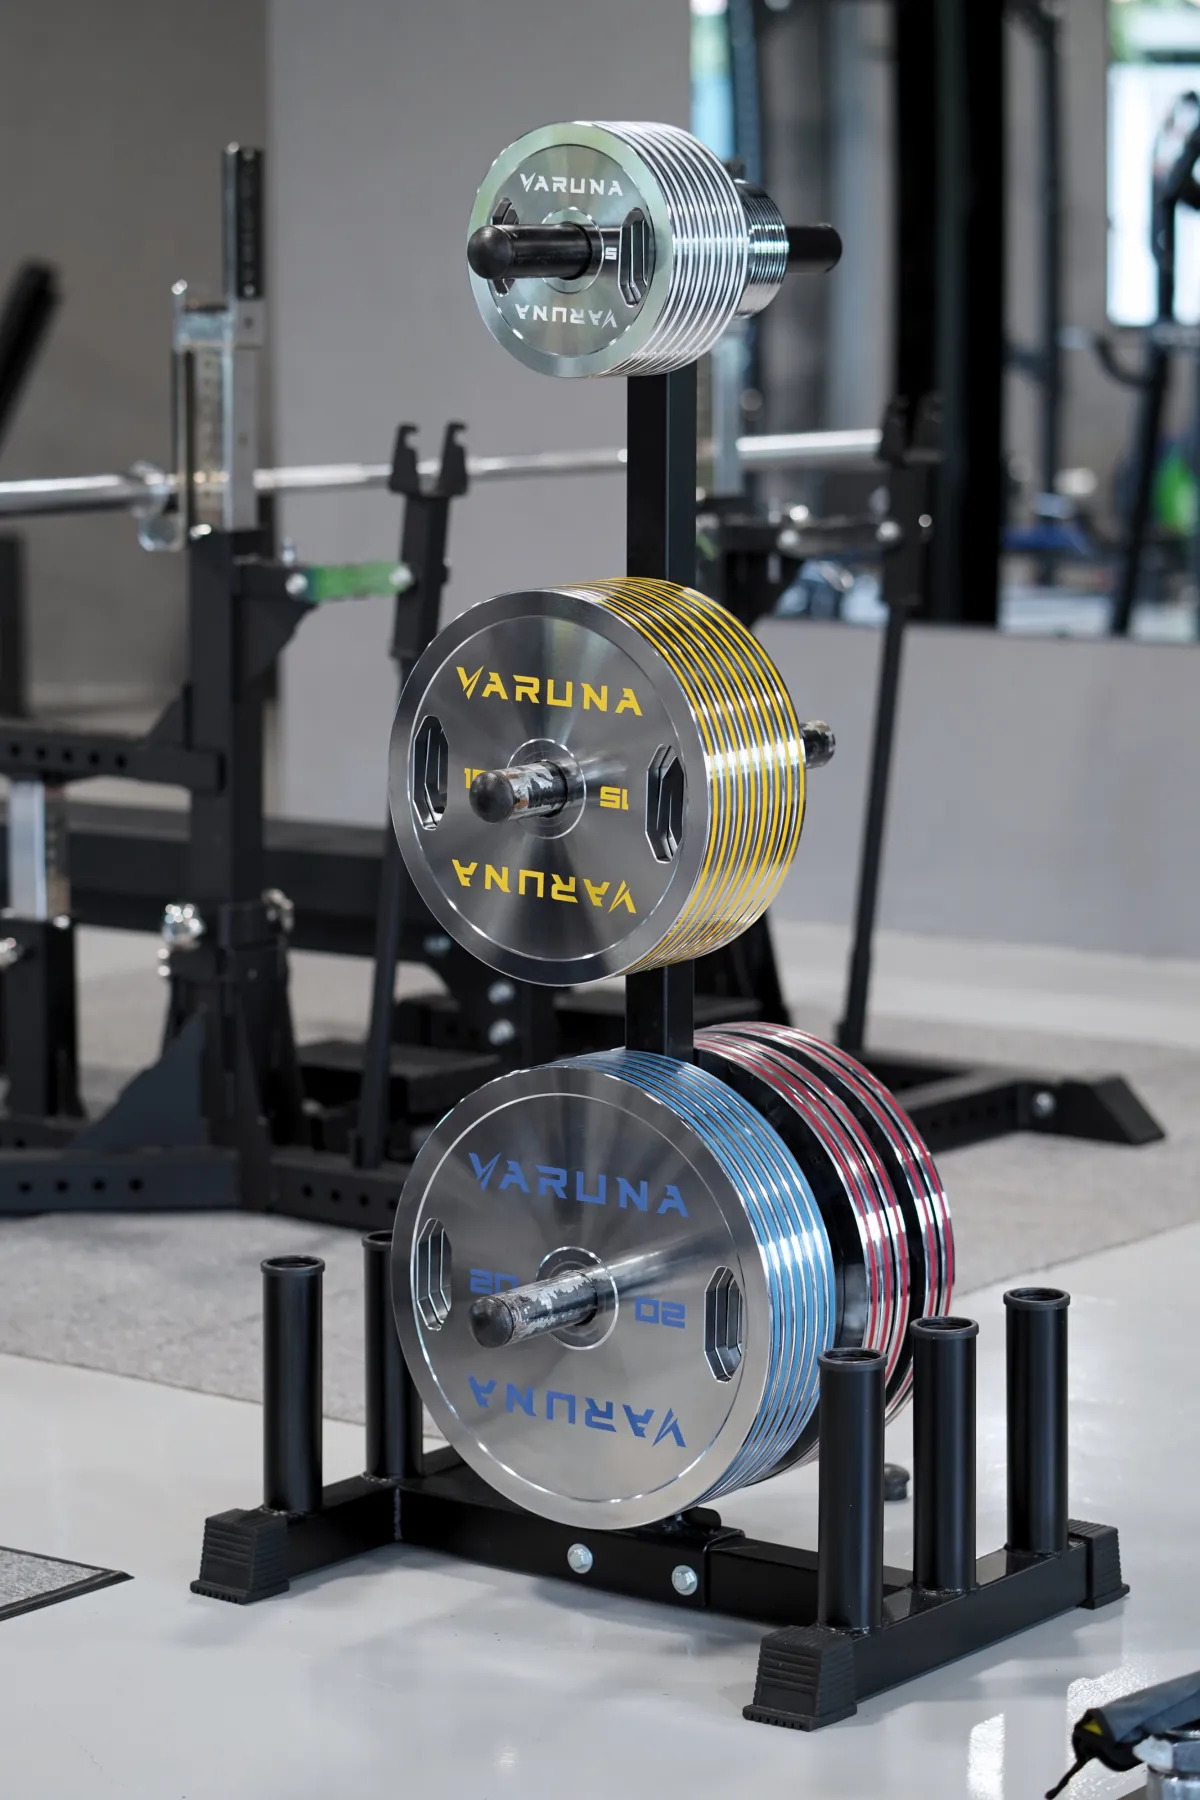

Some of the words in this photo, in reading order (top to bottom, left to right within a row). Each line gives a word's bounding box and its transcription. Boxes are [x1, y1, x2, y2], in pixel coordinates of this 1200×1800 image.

[520, 173, 623, 197] VARUNA
[515, 303, 618, 328] VARUNA
[456, 665, 643, 716] VARUNA
[600, 786, 629, 810] 15
[452, 859, 637, 914] VARUNA
[468, 1152, 690, 1218] VARUNA
[635, 1297, 686, 1329] 20
[468, 1373, 687, 1448] VARUNA
